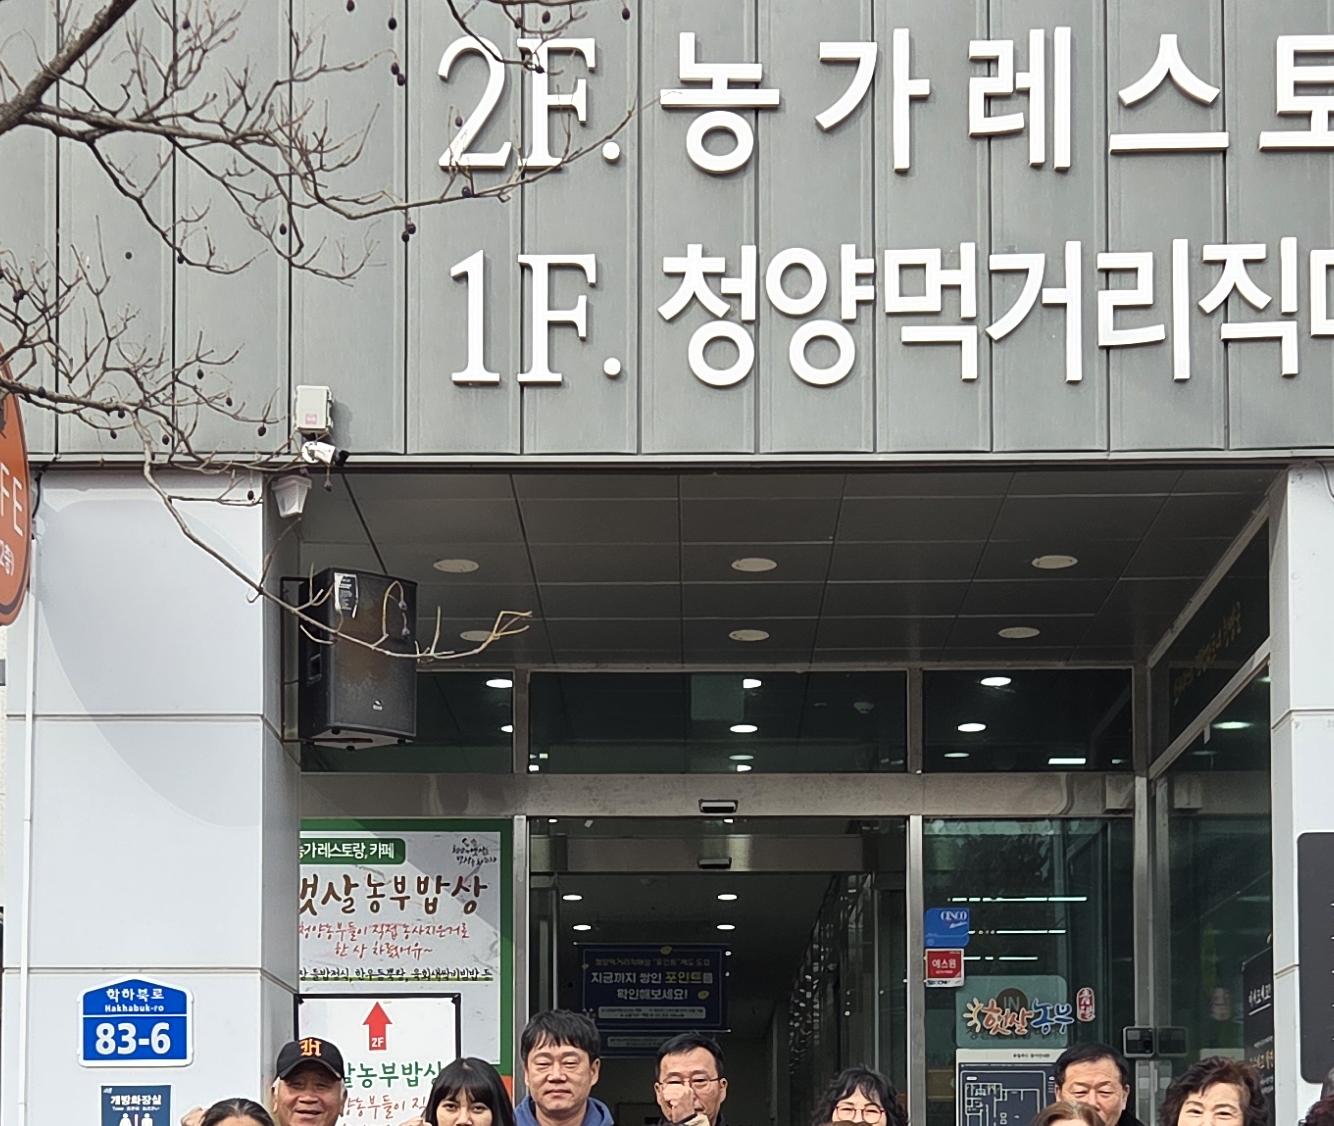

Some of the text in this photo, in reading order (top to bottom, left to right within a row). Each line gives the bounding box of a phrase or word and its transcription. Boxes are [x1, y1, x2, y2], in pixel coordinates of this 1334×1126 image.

[437, 36, 623, 171] 2F.
[449, 249, 624, 386] 1F.
[370, 842, 396, 860] 카페
[372, 923, 398, 940] 직접
[335, 942, 348, 957] 한
[353, 944, 367, 959] 상
[106, 988, 165, 1002] 학하북로
[105, 1003, 164, 1012] Hakhabuk-ro
[980, 998, 1075, 1036] 햇살농부
[95, 1022, 171, 1055] 83-6
[371, 1037, 384, 1048] 2F
[110, 1094, 162, 1105] 개방화장실
